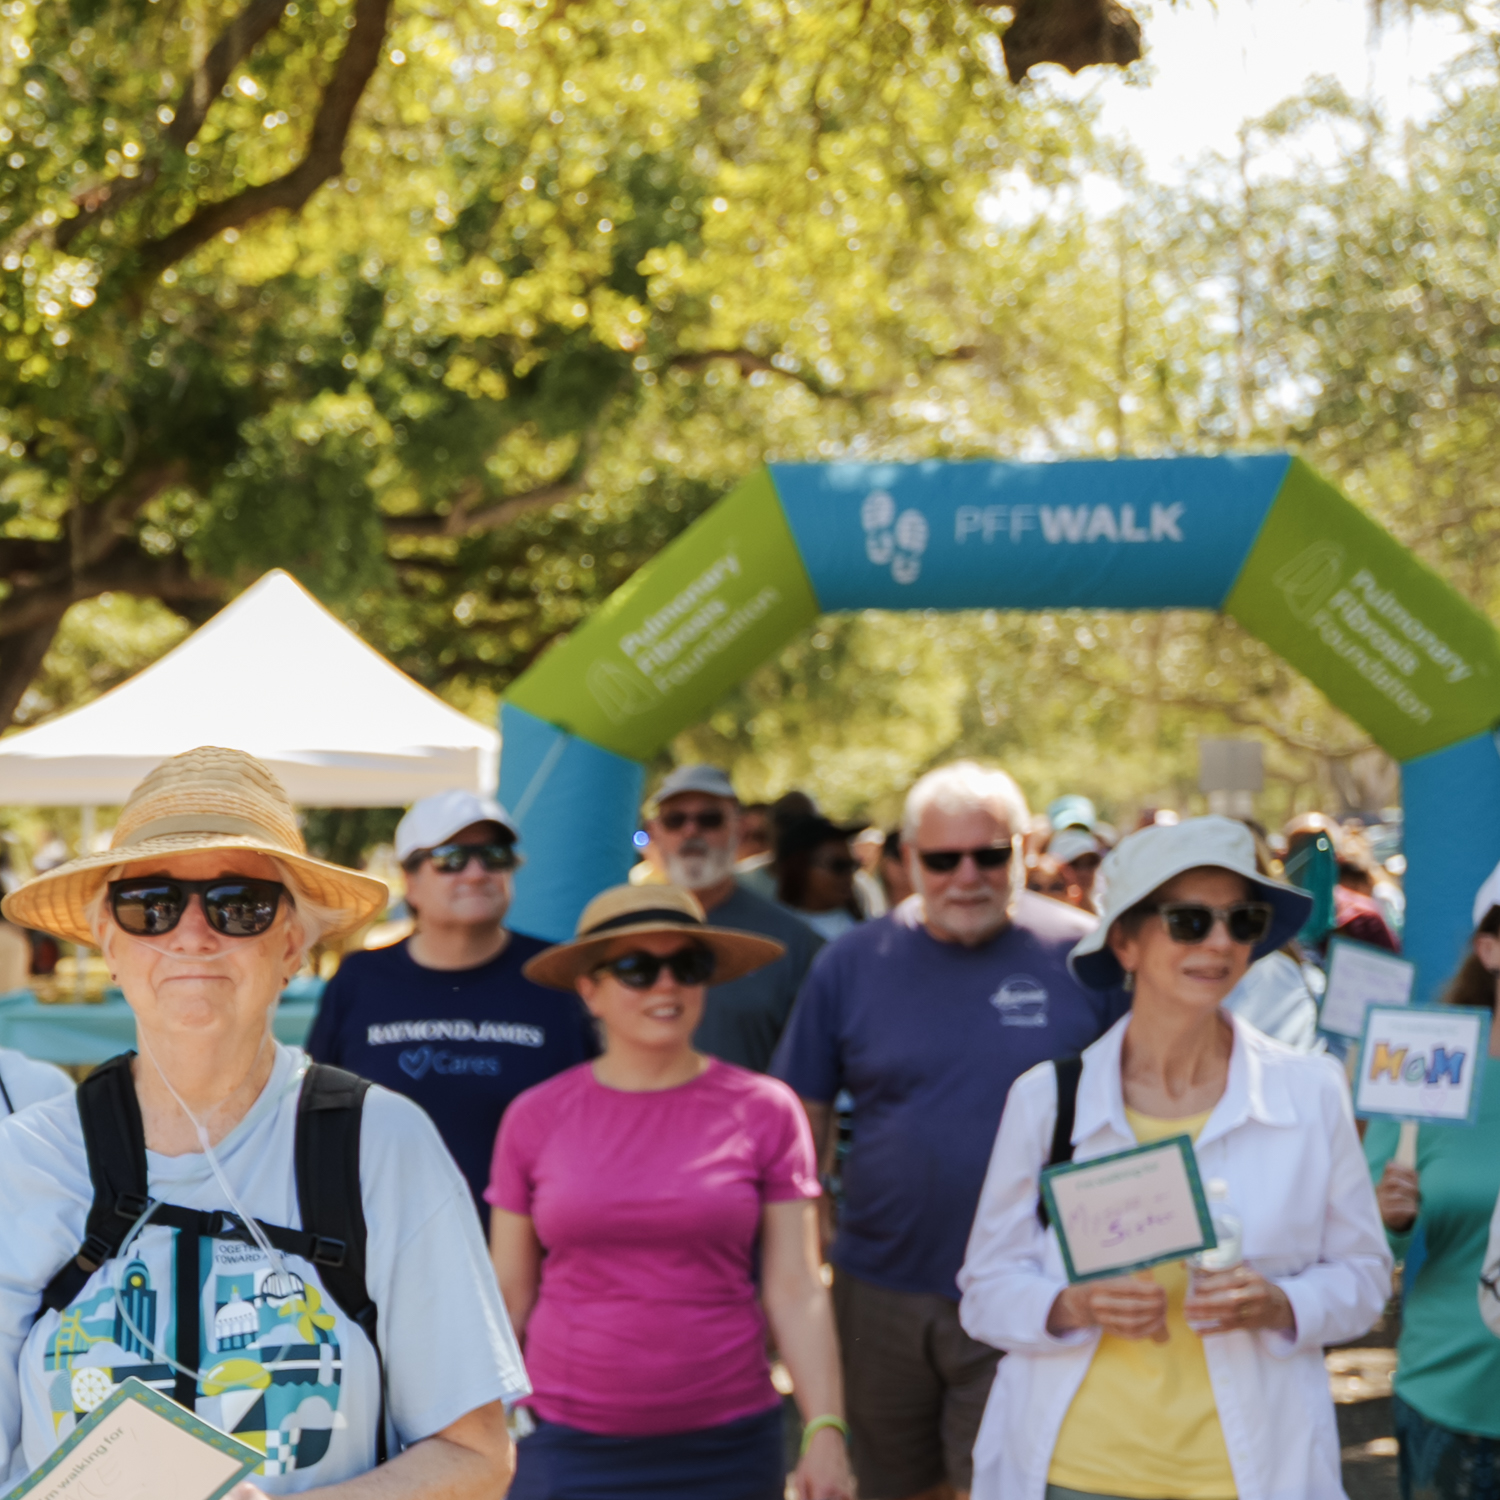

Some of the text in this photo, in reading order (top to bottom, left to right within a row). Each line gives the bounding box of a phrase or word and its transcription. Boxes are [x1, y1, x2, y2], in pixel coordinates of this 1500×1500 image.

[954, 501, 1187, 544] PFFWALK
[619, 553, 741, 658] Pulmonary
[654, 586, 779, 696] Foundation
[1329, 588, 1419, 676] Fibrosis
[1351, 569, 1473, 683] Pulmonary
[1309, 609, 1432, 725] Foundation
[432, 1050, 501, 1076] Cares
[57, 1443, 108, 1491] walking
[103, 1426, 124, 1446] for
